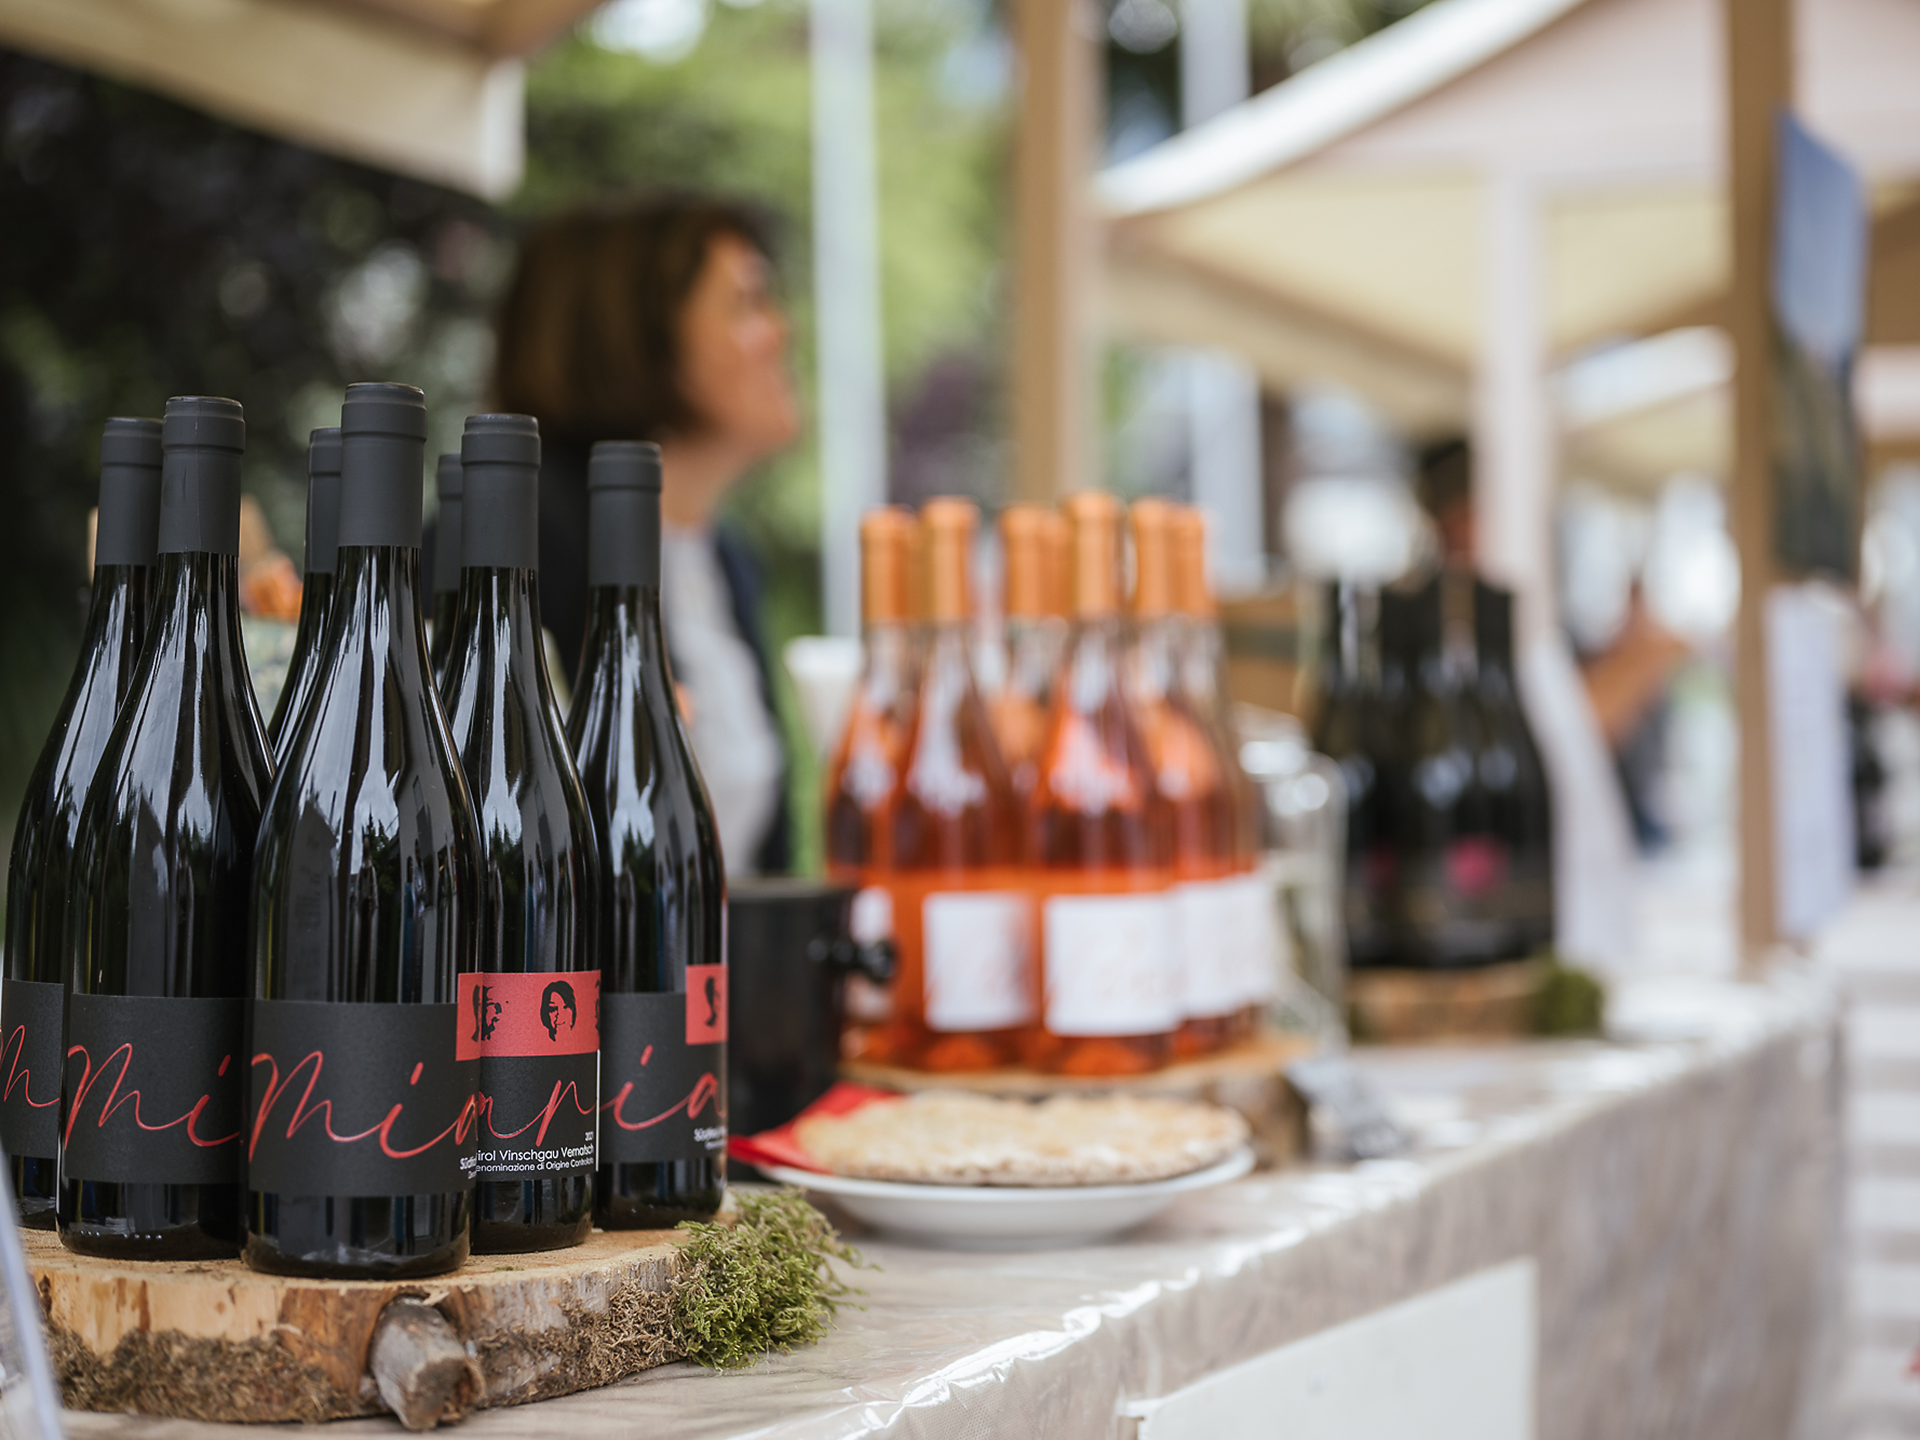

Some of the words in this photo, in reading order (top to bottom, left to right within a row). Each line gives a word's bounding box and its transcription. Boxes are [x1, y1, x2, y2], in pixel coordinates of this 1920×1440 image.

[476, 1149, 496, 1161] irol
[500, 1148, 559, 1163] Vinschgau
[475, 1161, 535, 1173] enominazione
[536, 1161, 545, 1170] di
[546, 1160, 570, 1171] Origine
